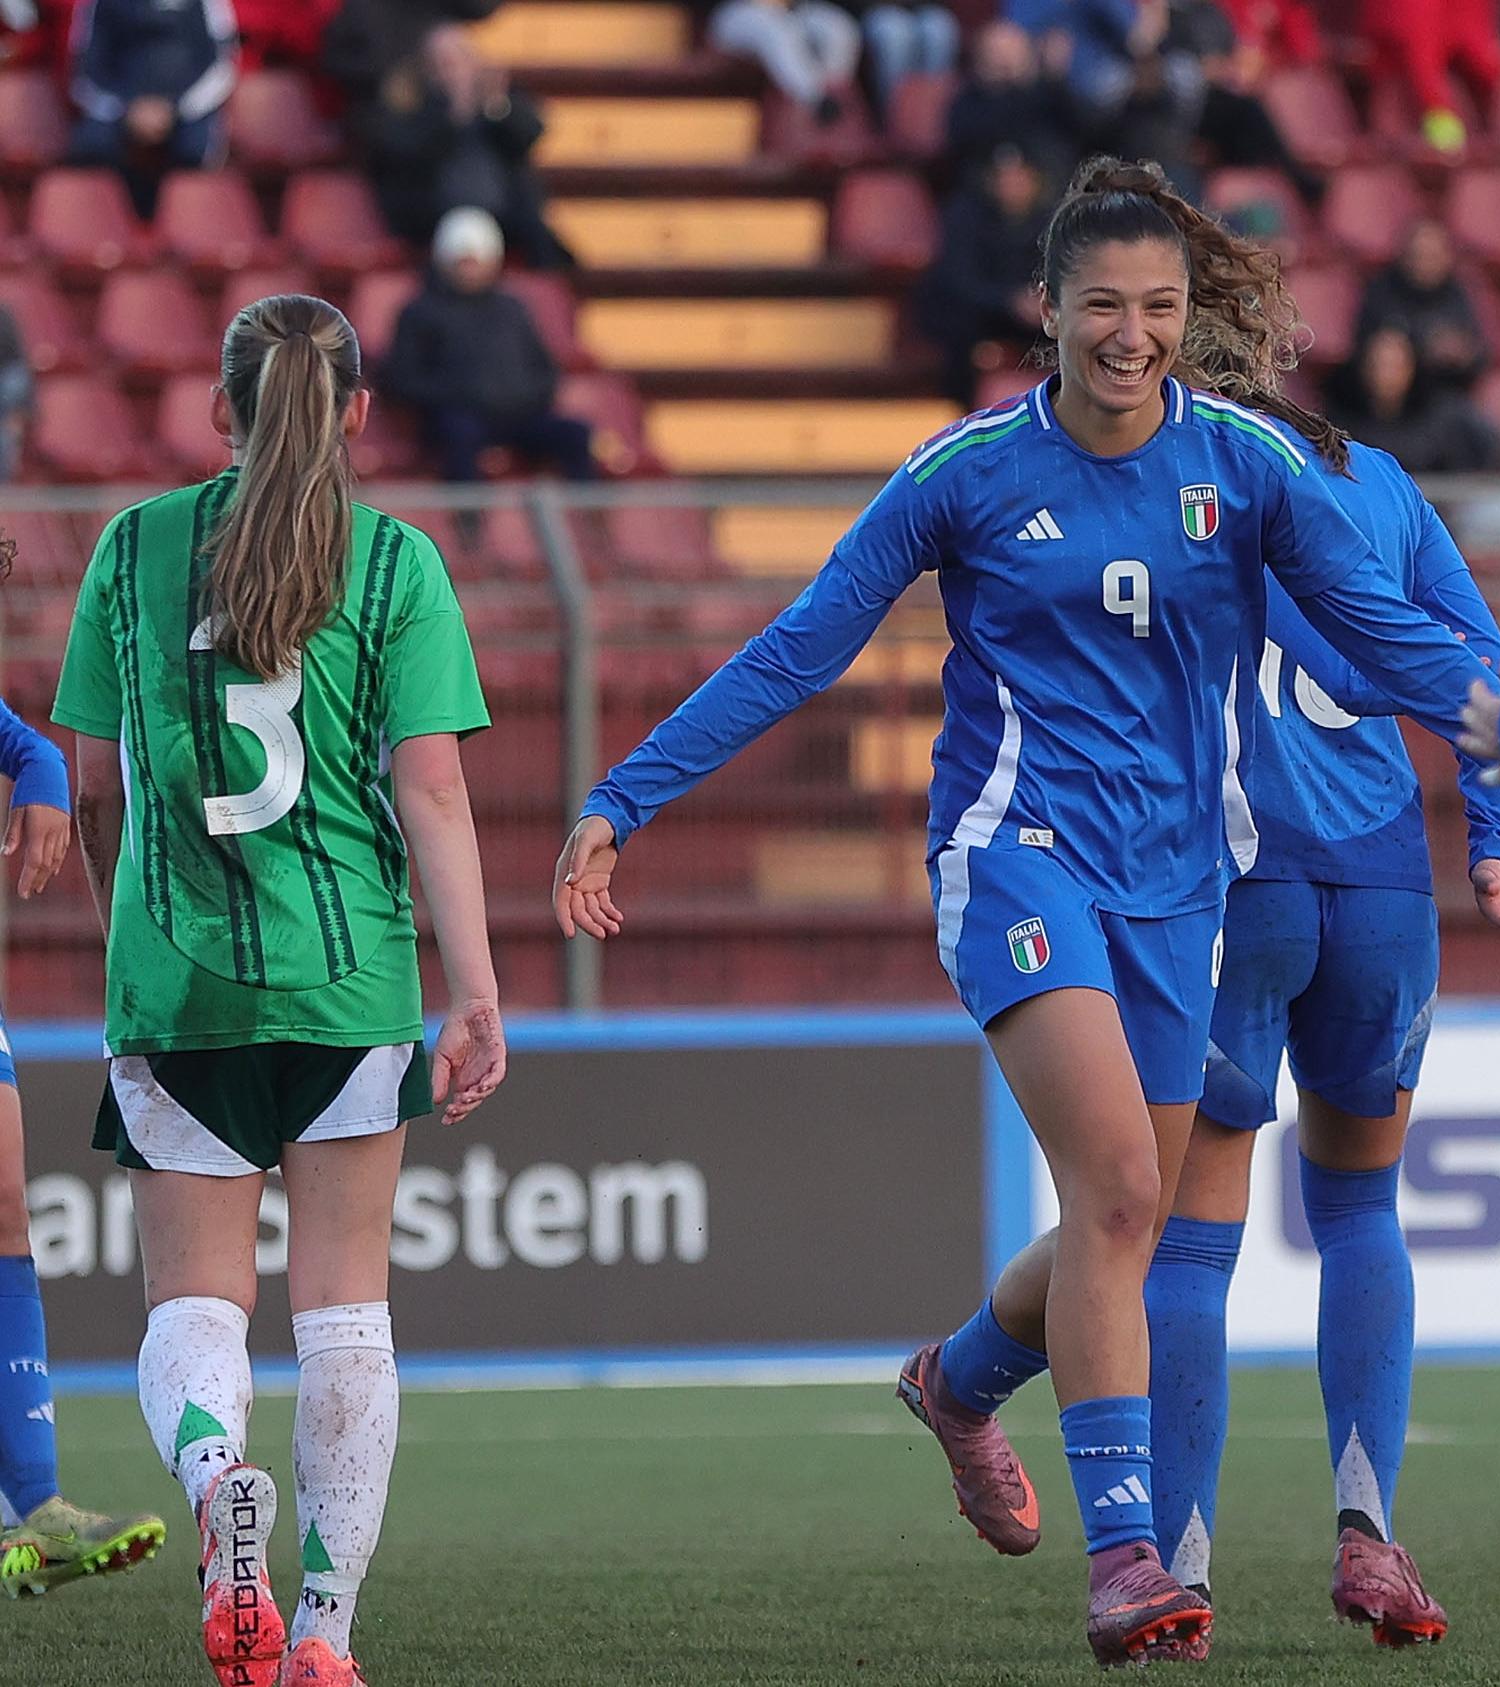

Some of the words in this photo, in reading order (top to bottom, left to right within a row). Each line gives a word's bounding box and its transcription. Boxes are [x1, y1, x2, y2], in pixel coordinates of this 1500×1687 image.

[1183, 488, 1214, 503] ITALIA
[1102, 560, 1150, 638] 9
[188, 611, 306, 837] 3
[1010, 921, 1041, 942] ITALIA
[231, 1478, 260, 1686] PREDATOR
